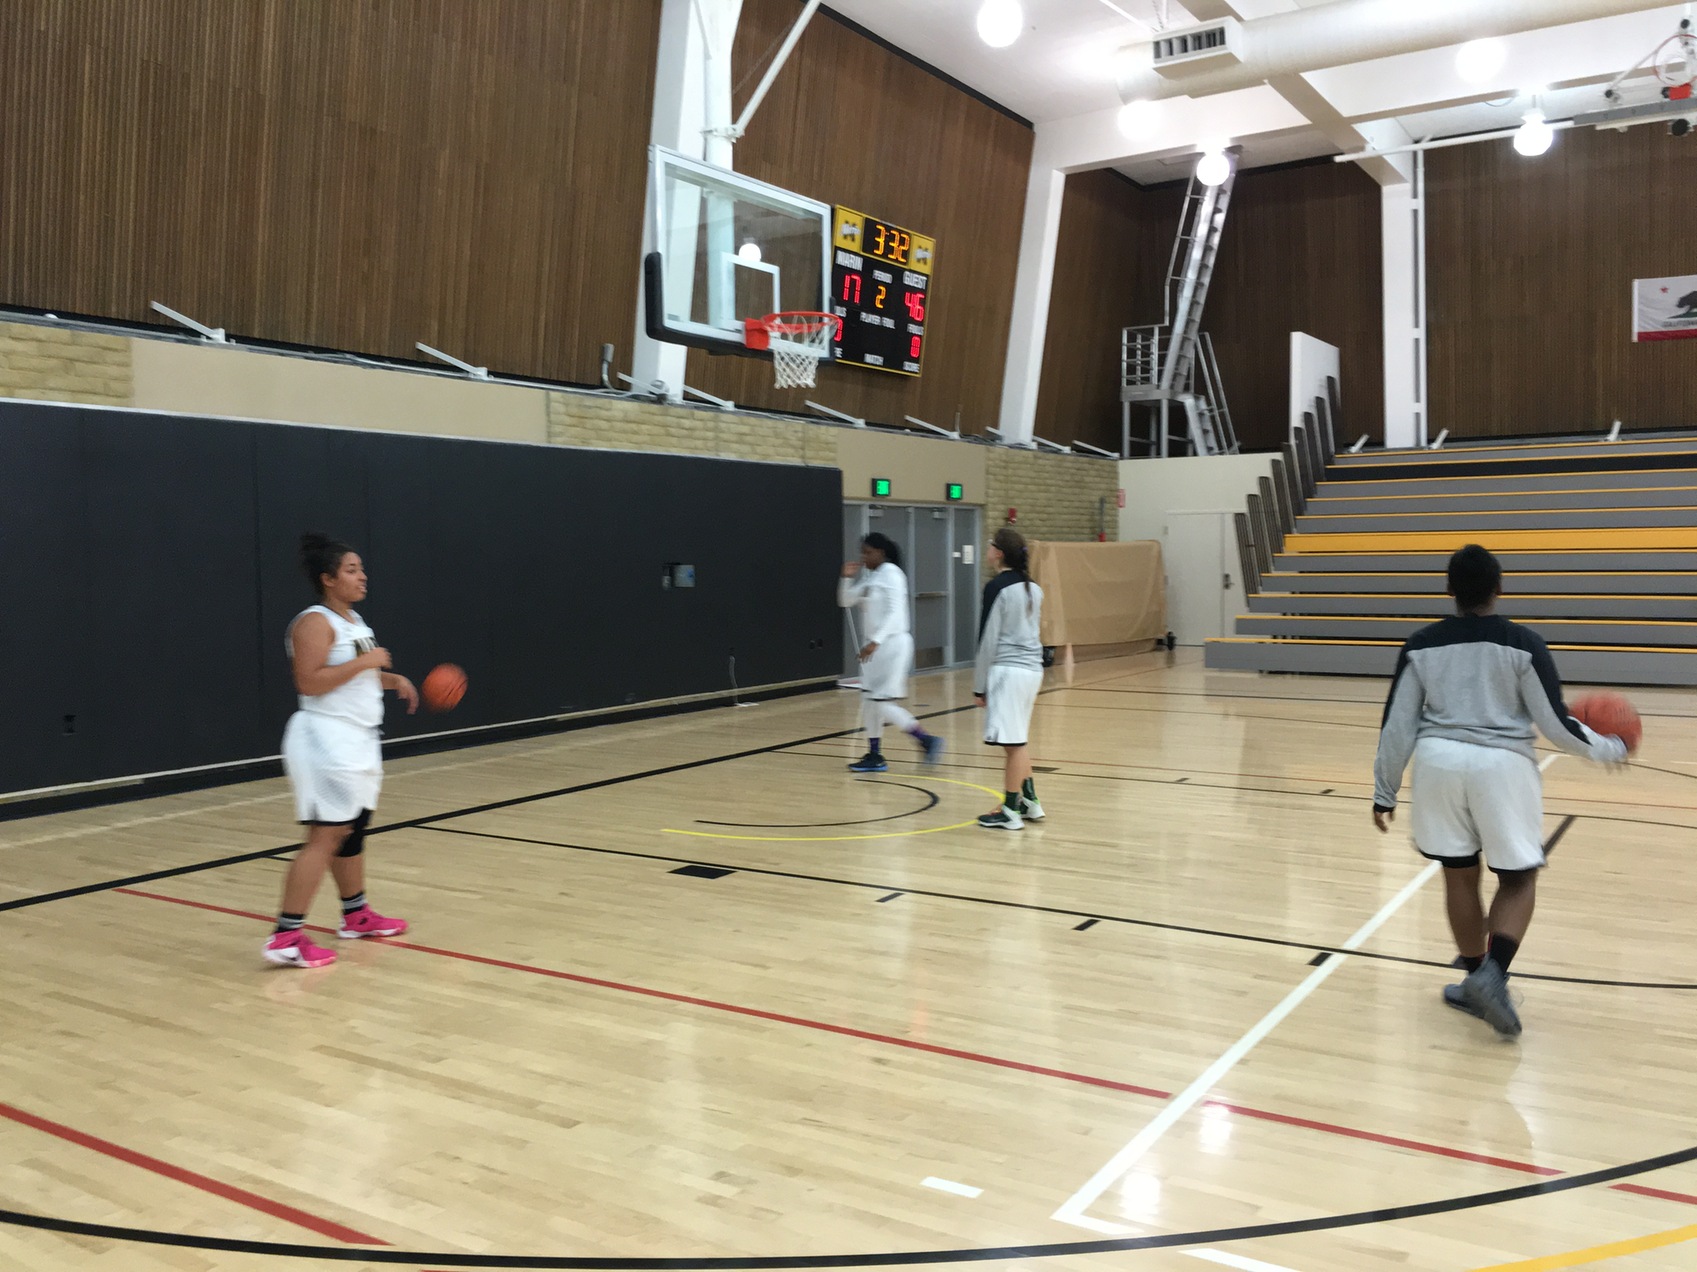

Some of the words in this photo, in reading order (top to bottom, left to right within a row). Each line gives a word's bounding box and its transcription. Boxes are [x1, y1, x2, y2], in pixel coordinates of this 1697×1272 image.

[843, 274, 862, 304] 17
[902, 271, 927, 290] GUEST
[875, 285, 886, 309] 2
[904, 291, 925, 322] 46
